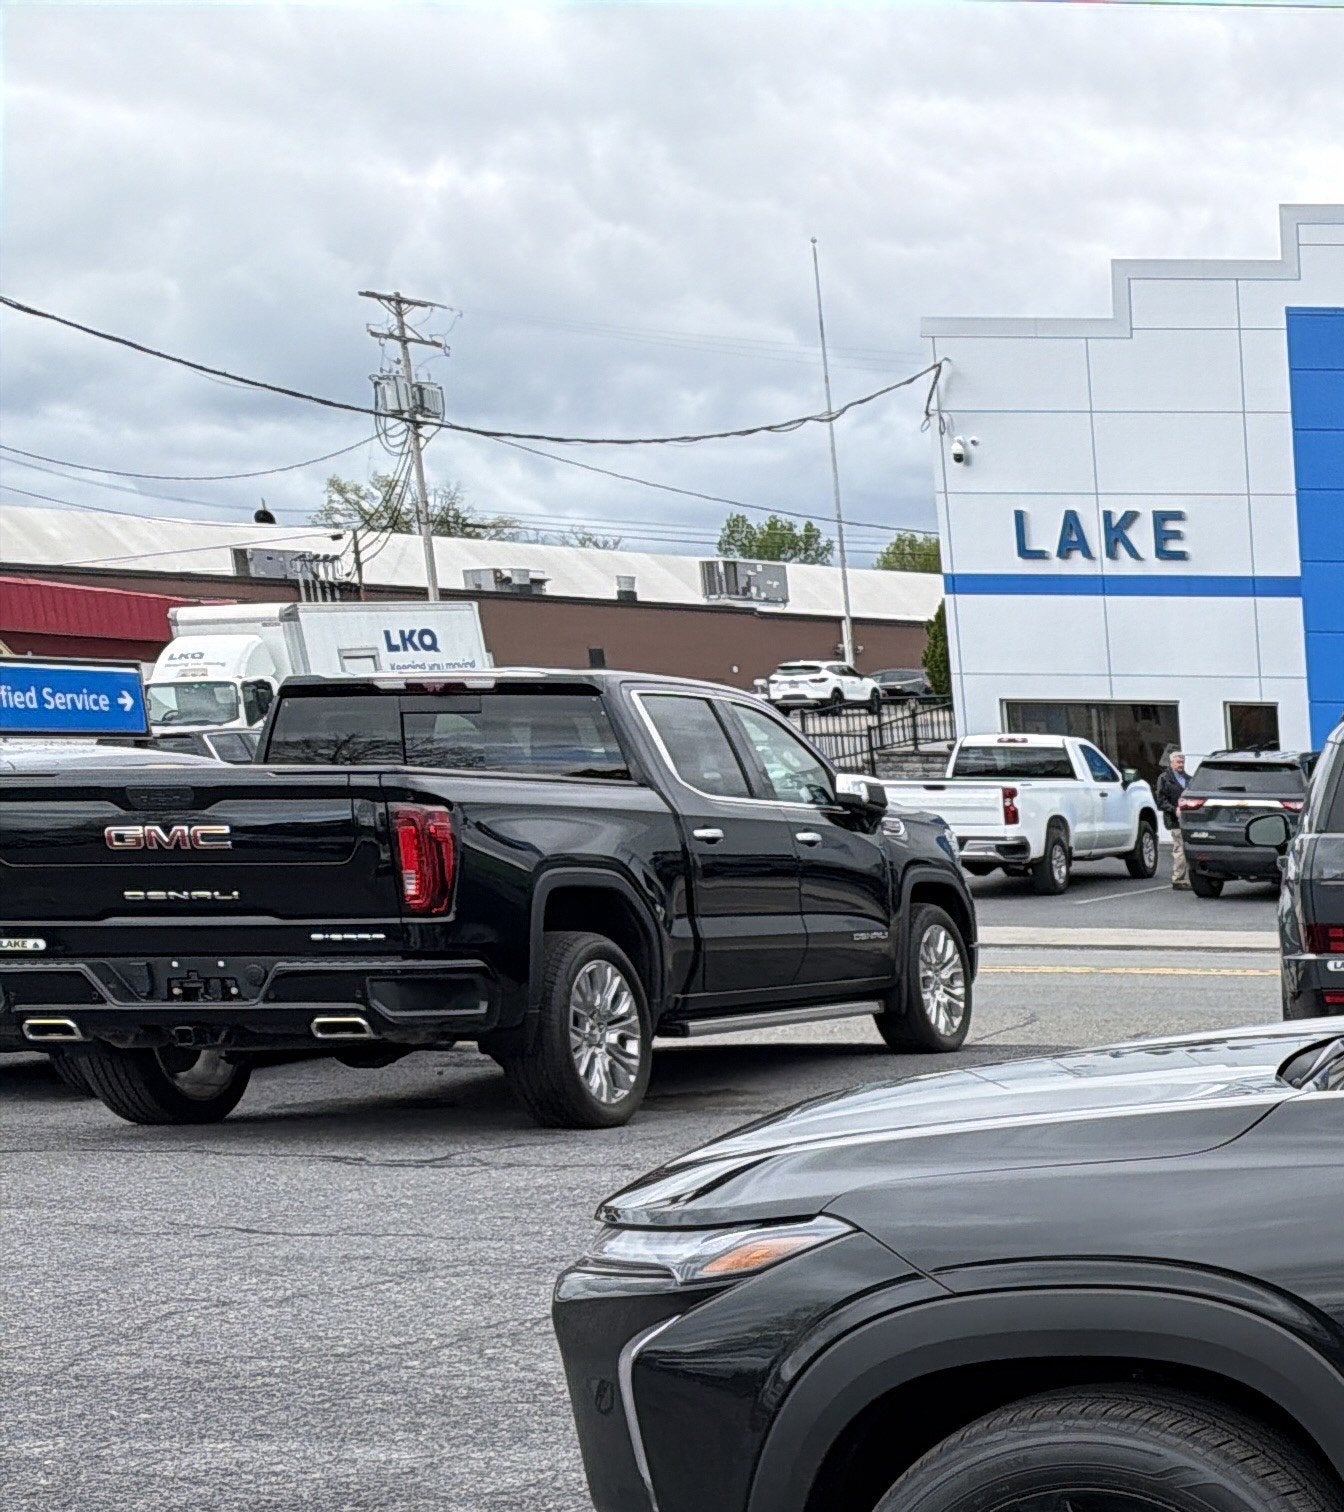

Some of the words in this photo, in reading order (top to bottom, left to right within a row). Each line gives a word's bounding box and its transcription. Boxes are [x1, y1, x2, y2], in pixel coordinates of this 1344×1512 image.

[1014, 510, 1189, 560] LAKE
[383, 629, 441, 652] LKQ
[168, 652, 205, 661] LKQ
[42, 687, 110, 711] Service
[104, 826, 232, 849] GMC
[0, 940, 28, 949] LAKE
